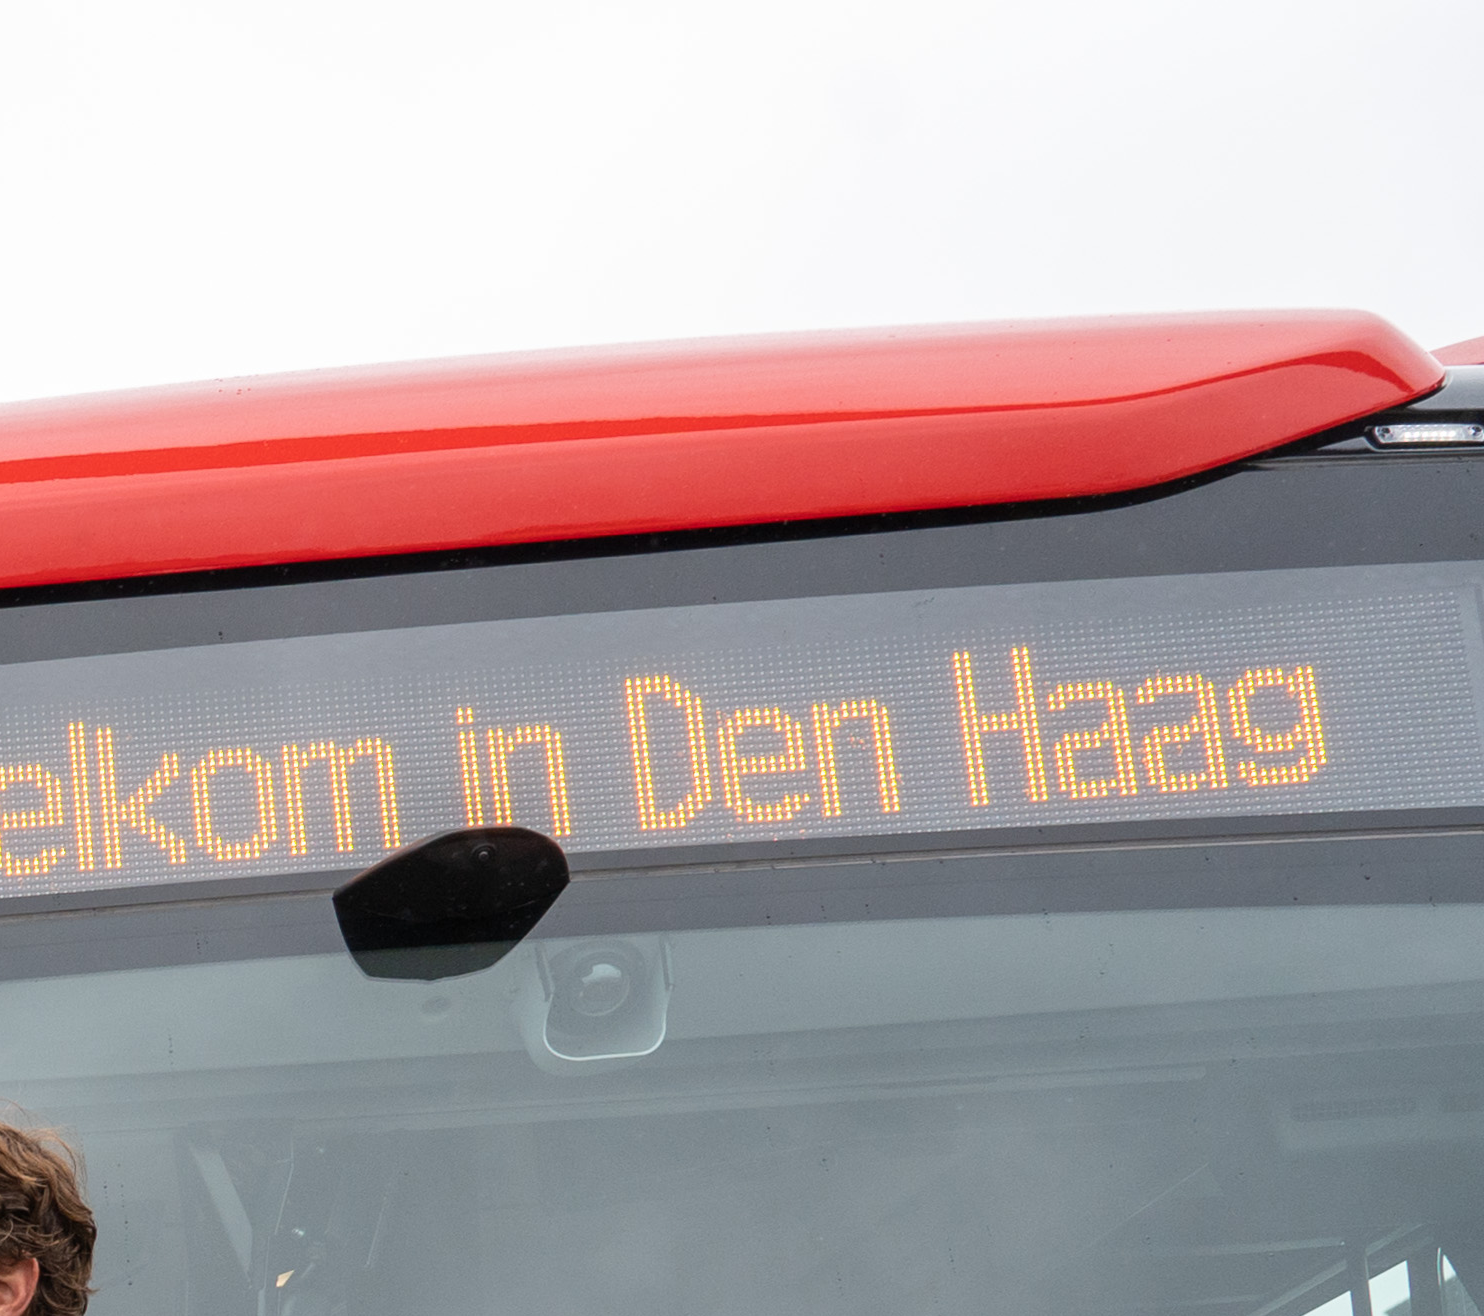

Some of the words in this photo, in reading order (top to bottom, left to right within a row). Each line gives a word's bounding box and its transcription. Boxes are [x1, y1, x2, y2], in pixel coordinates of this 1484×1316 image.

[460, 702, 572, 838] in
[627, 670, 900, 832] Den
[952, 644, 1332, 806] Haag
